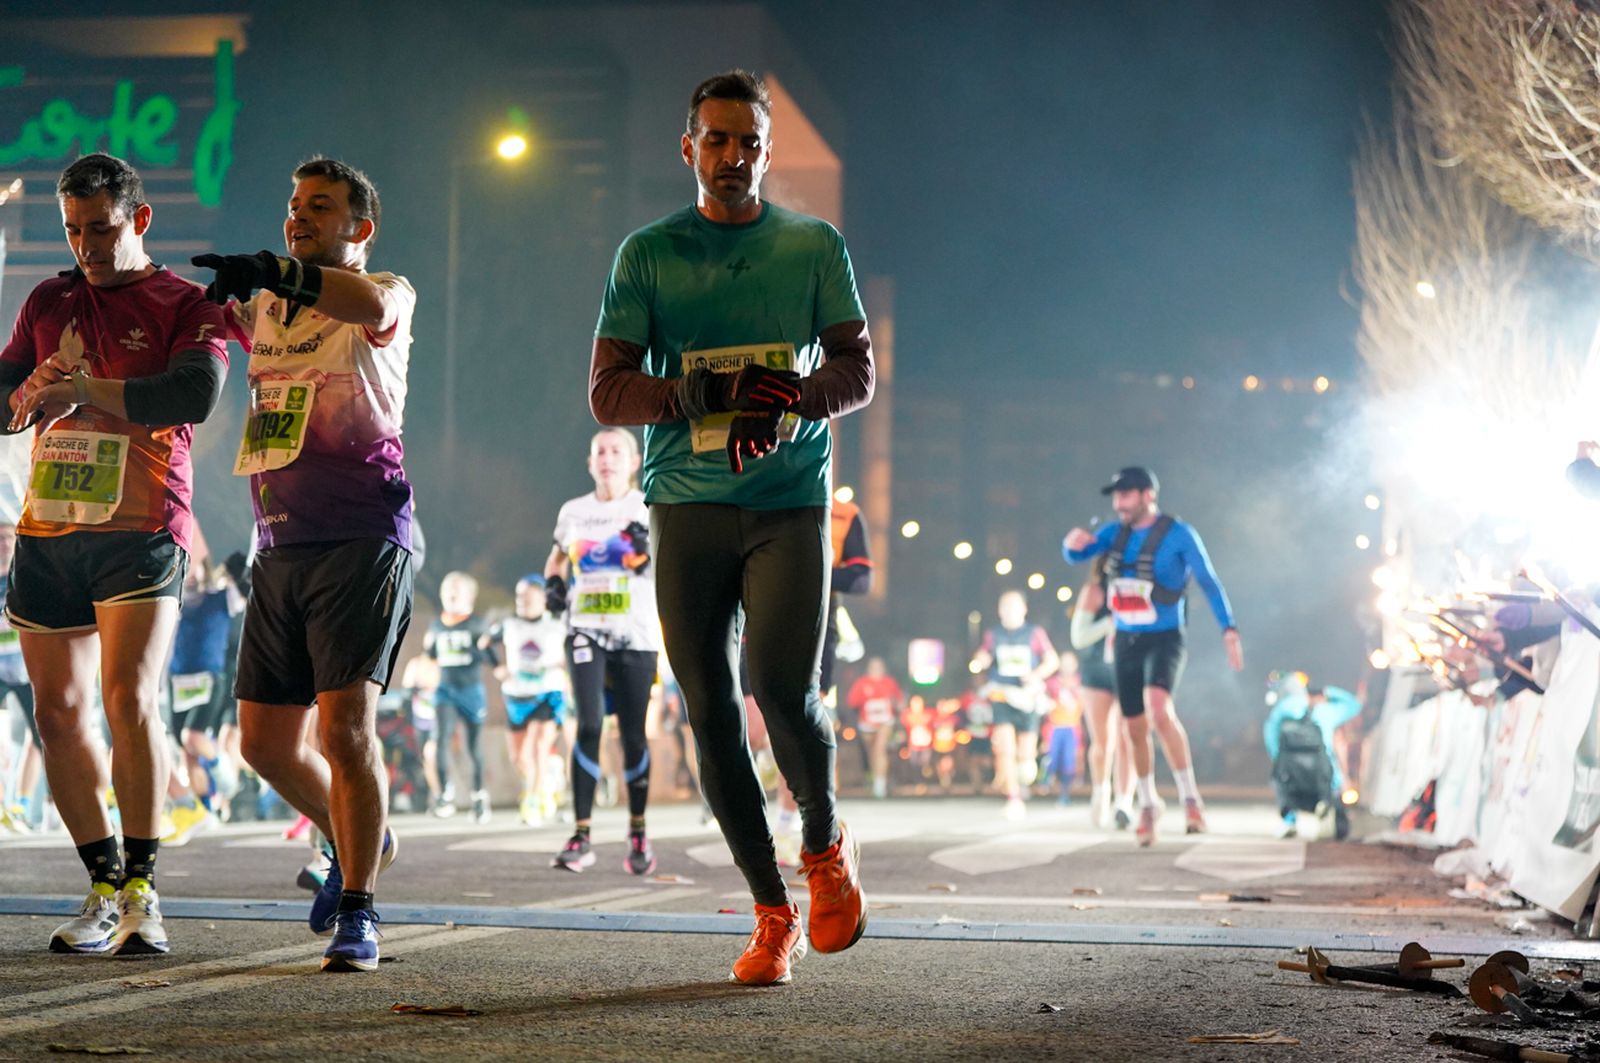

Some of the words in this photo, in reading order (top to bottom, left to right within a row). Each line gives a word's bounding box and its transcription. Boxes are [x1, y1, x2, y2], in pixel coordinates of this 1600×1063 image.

[709, 357, 742, 370] NOCHE
[77, 441, 88, 451] DE
[41, 451, 54, 461] SAN
[53, 463, 95, 492] 752
